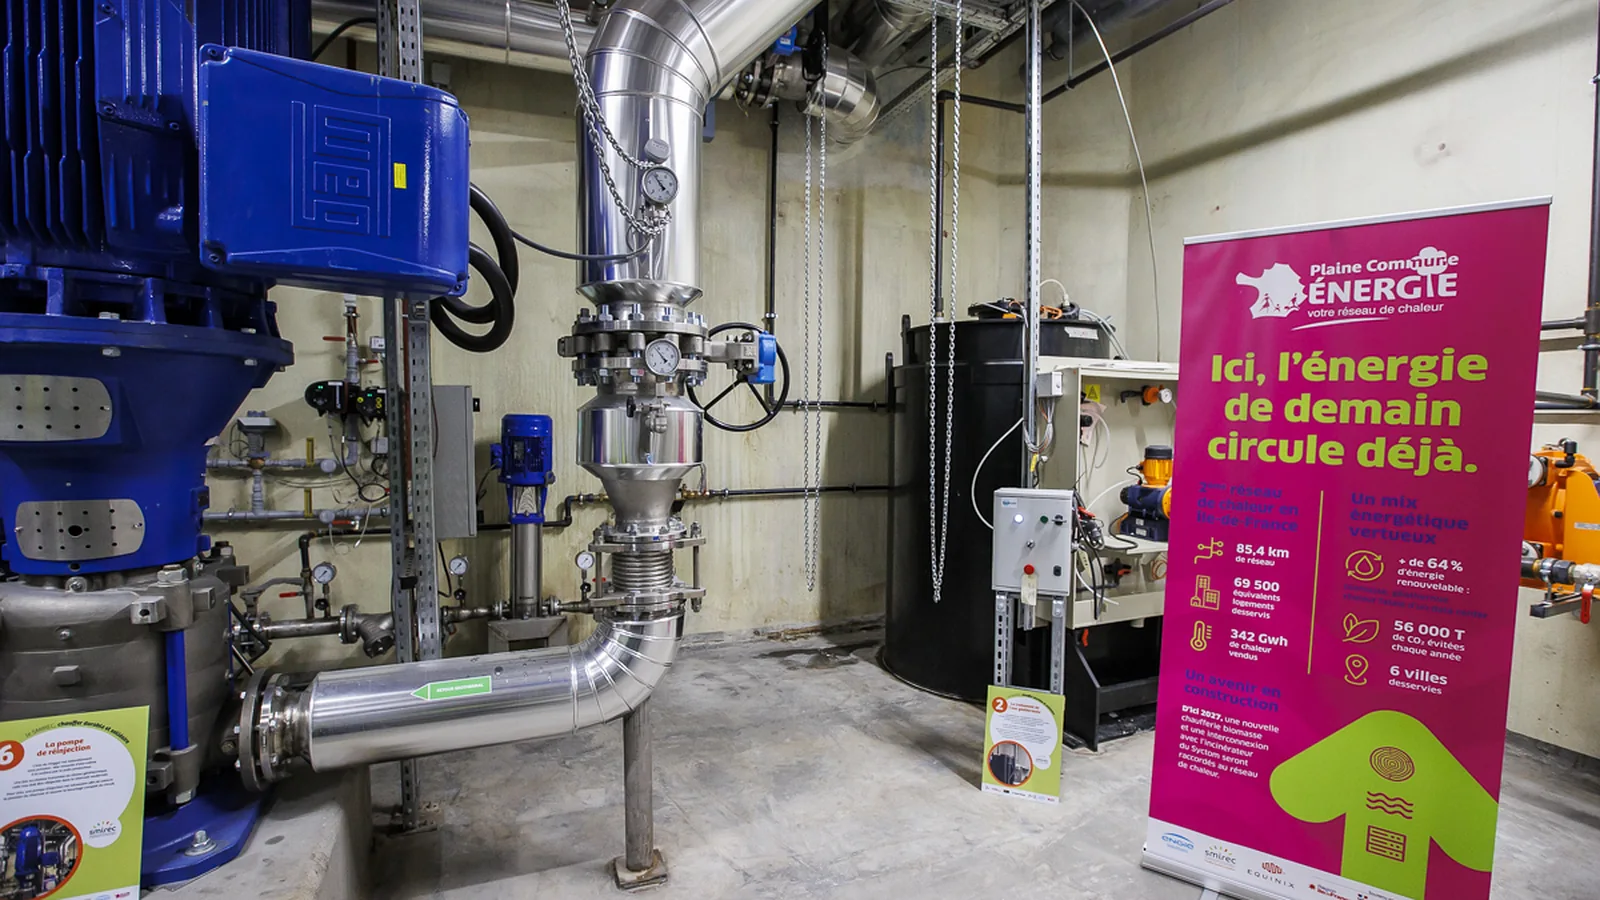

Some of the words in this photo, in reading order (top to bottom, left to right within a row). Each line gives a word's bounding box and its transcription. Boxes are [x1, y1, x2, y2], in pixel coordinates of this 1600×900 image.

[1310, 262, 1362, 278] Plaine
[1367, 254, 1459, 273] Commune
[1308, 272, 1458, 305] ÉNERGIE
[1307, 309, 1336, 318] votre
[1338, 305, 1377, 317] réseau
[1379, 304, 1395, 315] de
[1398, 302, 1444, 314] chaleur
[1211, 352, 1266, 387] Ici,
[1278, 348, 1488, 388] l'énergie
[1224, 393, 1273, 422] de
[1284, 393, 1461, 427] demain
[1207, 431, 1344, 466] circule
[1357, 437, 1478, 476] déjà.
[1230, 483, 1283, 498] réseau
[1197, 497, 1215, 508] de
[1219, 499, 1274, 514] chaleur
[1279, 505, 1299, 516] en
[1350, 492, 1375, 506] Un
[1381, 495, 1418, 509] mix
[1350, 508, 1469, 531] énergétique
[1348, 526, 1437, 545] vertueux
[1236, 543, 1265, 557] 85,4
[1268, 546, 1290, 558] km
[1235, 556, 1245, 564] de
[1247, 557, 1275, 567] réseau
[1409, 558, 1424, 568] de
[1234, 577, 1250, 589] 69
[1254, 580, 1280, 592] 500
[1397, 579, 1464, 594] renouvelable
[1233, 589, 1281, 602] équivalents
[1231, 607, 1271, 619] desservis
[1232, 598, 1275, 611] logements
[1230, 628, 1255, 642] 342
[1258, 633, 1289, 647] Gwh
[1394, 620, 1414, 633] 56
[1418, 624, 1450, 639] 000
[1454, 629, 1465, 641] T
[1229, 641, 1239, 649] de
[1241, 643, 1272, 654] chaleur
[1392, 633, 1405, 642] de
[1427, 637, 1465, 652] évitées
[1229, 650, 1258, 661] vendus
[1391, 643, 1427, 657] chaque
[1429, 649, 1462, 662] année
[1185, 669, 1205, 683] Un
[1208, 677, 1258, 694] avenir
[1261, 687, 1281, 699] en
[1390, 665, 1400, 676] 6
[1404, 669, 1448, 686] villes
[1389, 678, 1442, 695] desservies
[995, 699, 1004, 711] 2
[1184, 683, 1279, 712] construction
[1200, 708, 1224, 722] 2027,
[1224, 716, 1240, 726] une
[1242, 720, 1280, 734] nouvelle
[1179, 733, 1198, 744] avec
[1180, 724, 1189, 732] et
[1190, 726, 1206, 737] une
[1207, 730, 1269, 751] interconnexion
[1223, 725, 1263, 740] biomasse
[48, 744, 91, 755] réinjection
[56, 739, 84, 749] pompe
[0, 744, 14, 767] 6
[1179, 742, 1190, 751] du
[1222, 755, 1249, 767] seront
[1177, 761, 1188, 769] de
[1218, 763, 1228, 772] au
[1229, 765, 1258, 778] réseau
[1205, 850, 1236, 865] smirec
[1247, 868, 1295, 889] EQUINIX
